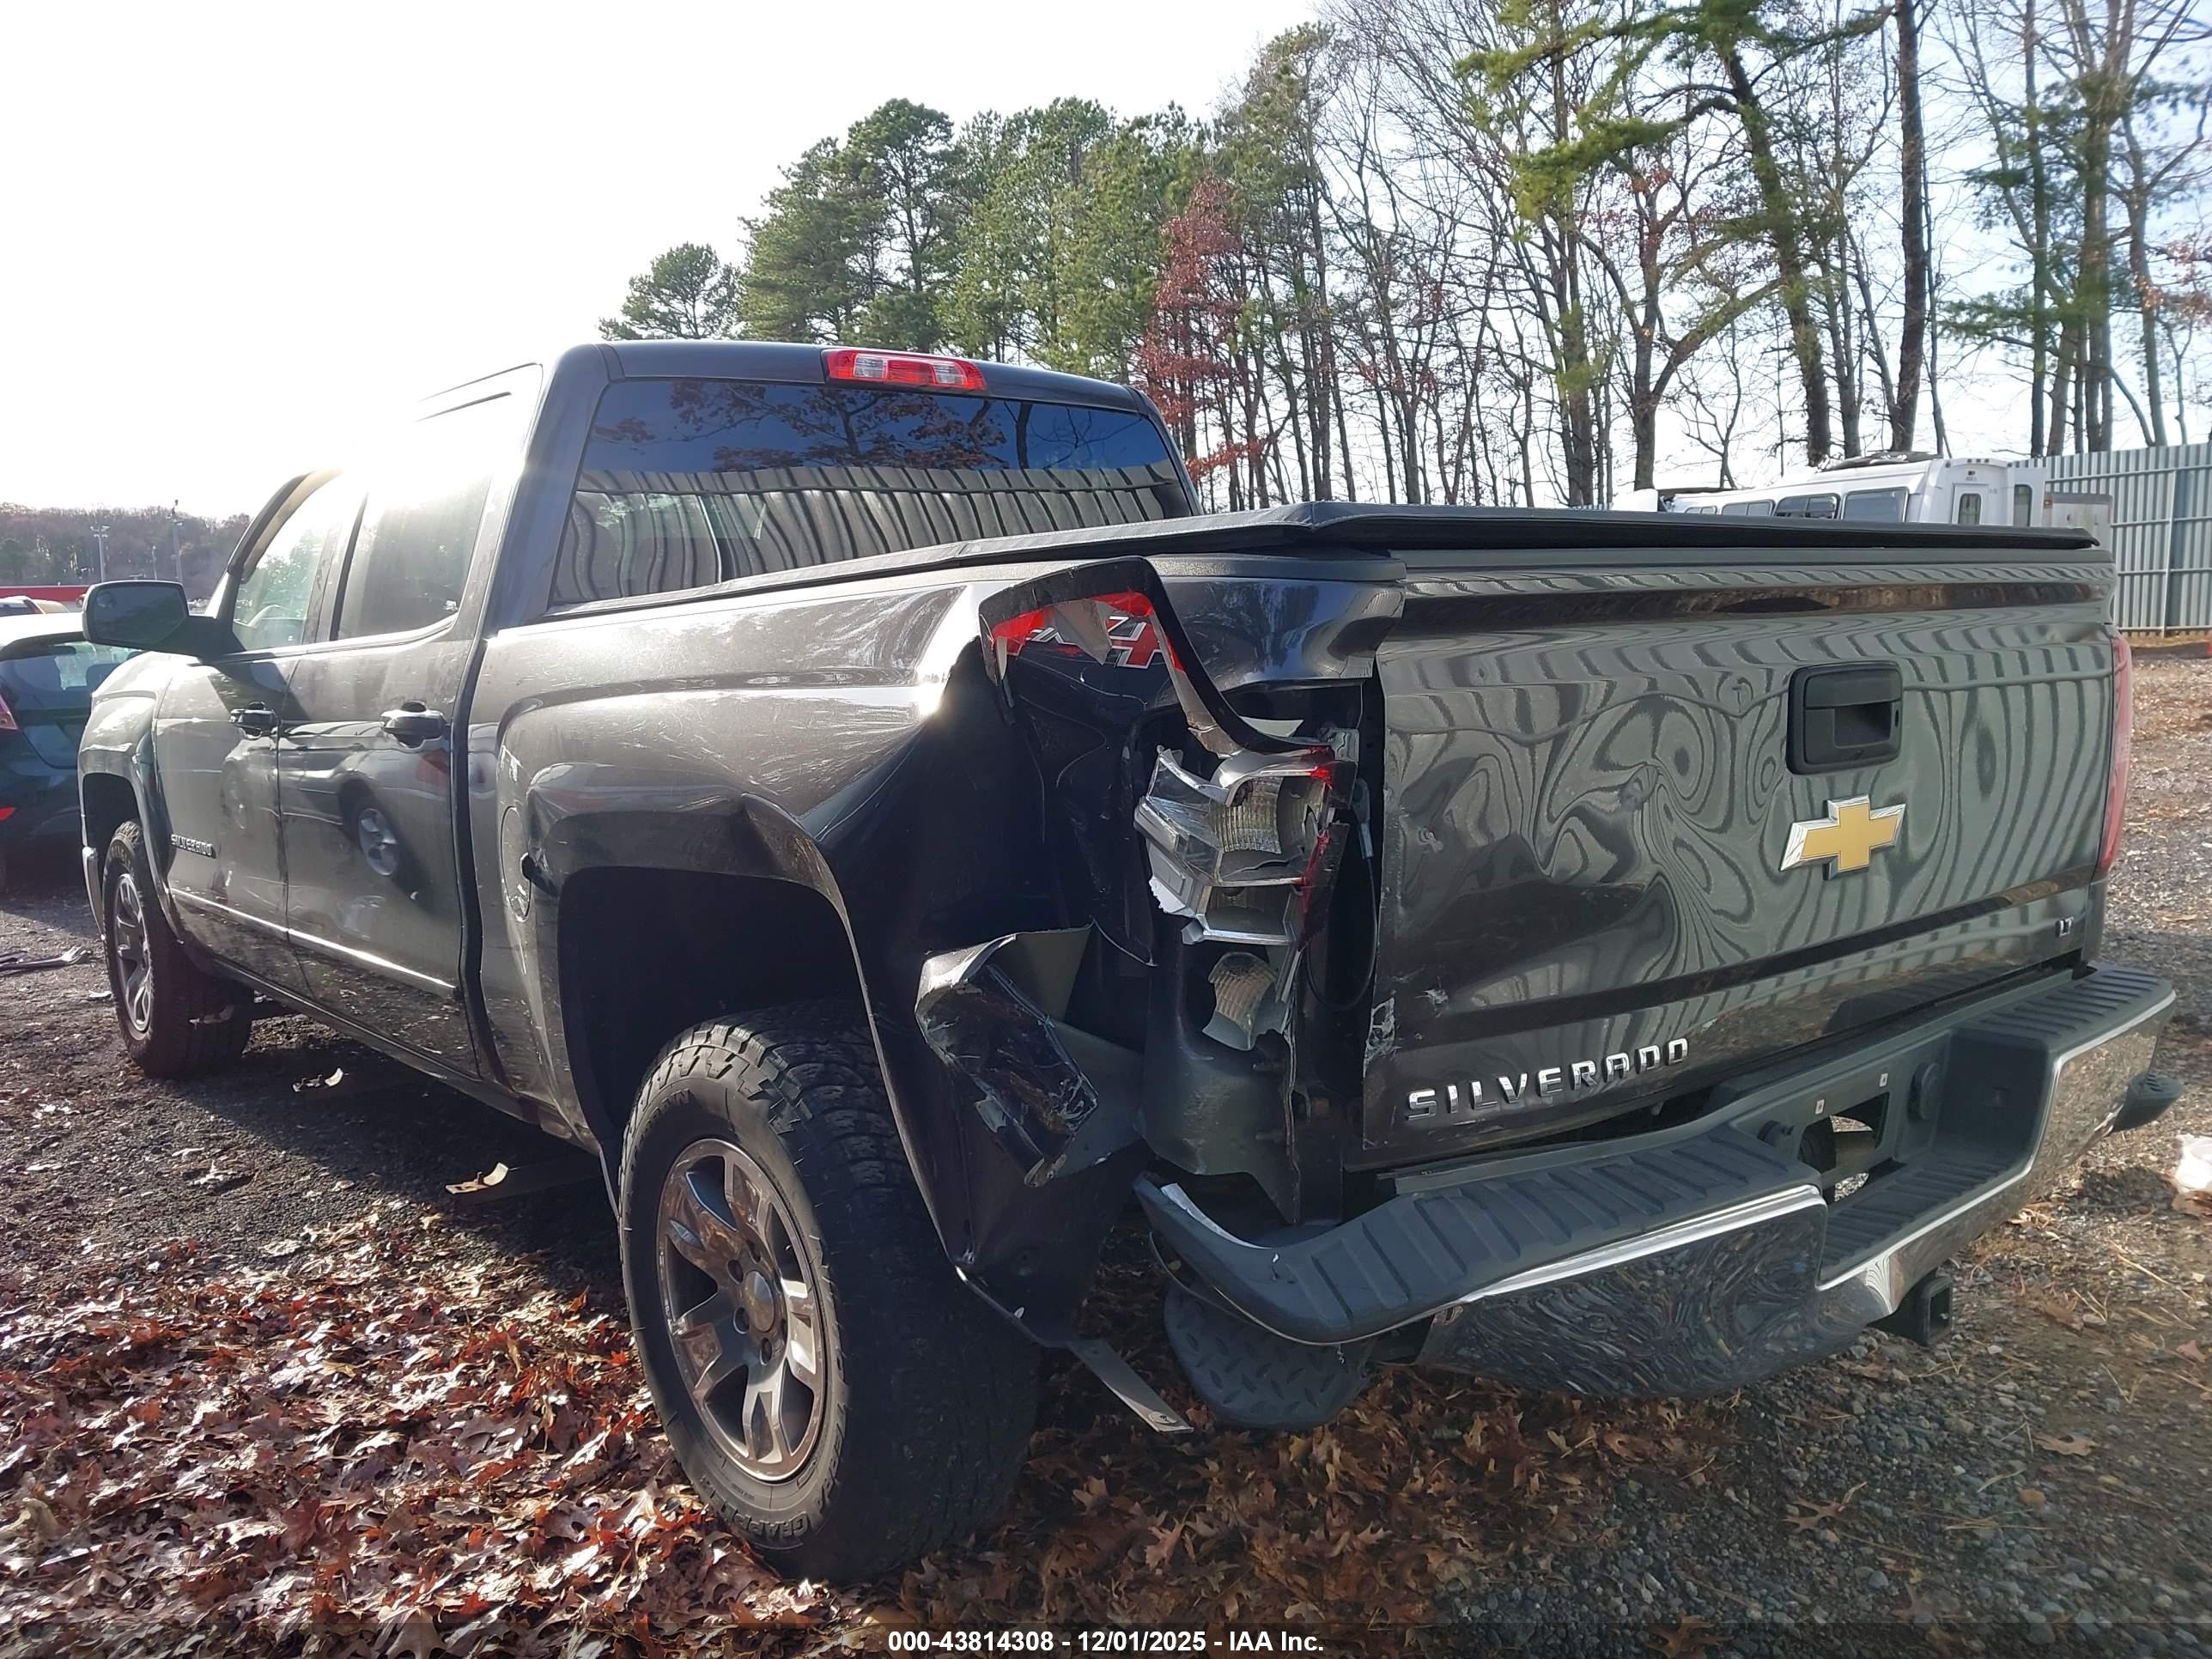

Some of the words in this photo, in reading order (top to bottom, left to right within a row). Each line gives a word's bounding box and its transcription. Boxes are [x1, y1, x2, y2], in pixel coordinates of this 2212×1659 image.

[170, 833, 215, 858] SILVERADO
[2059, 915, 2074, 937] LT
[1407, 1036, 1690, 1121] SILVERADO
